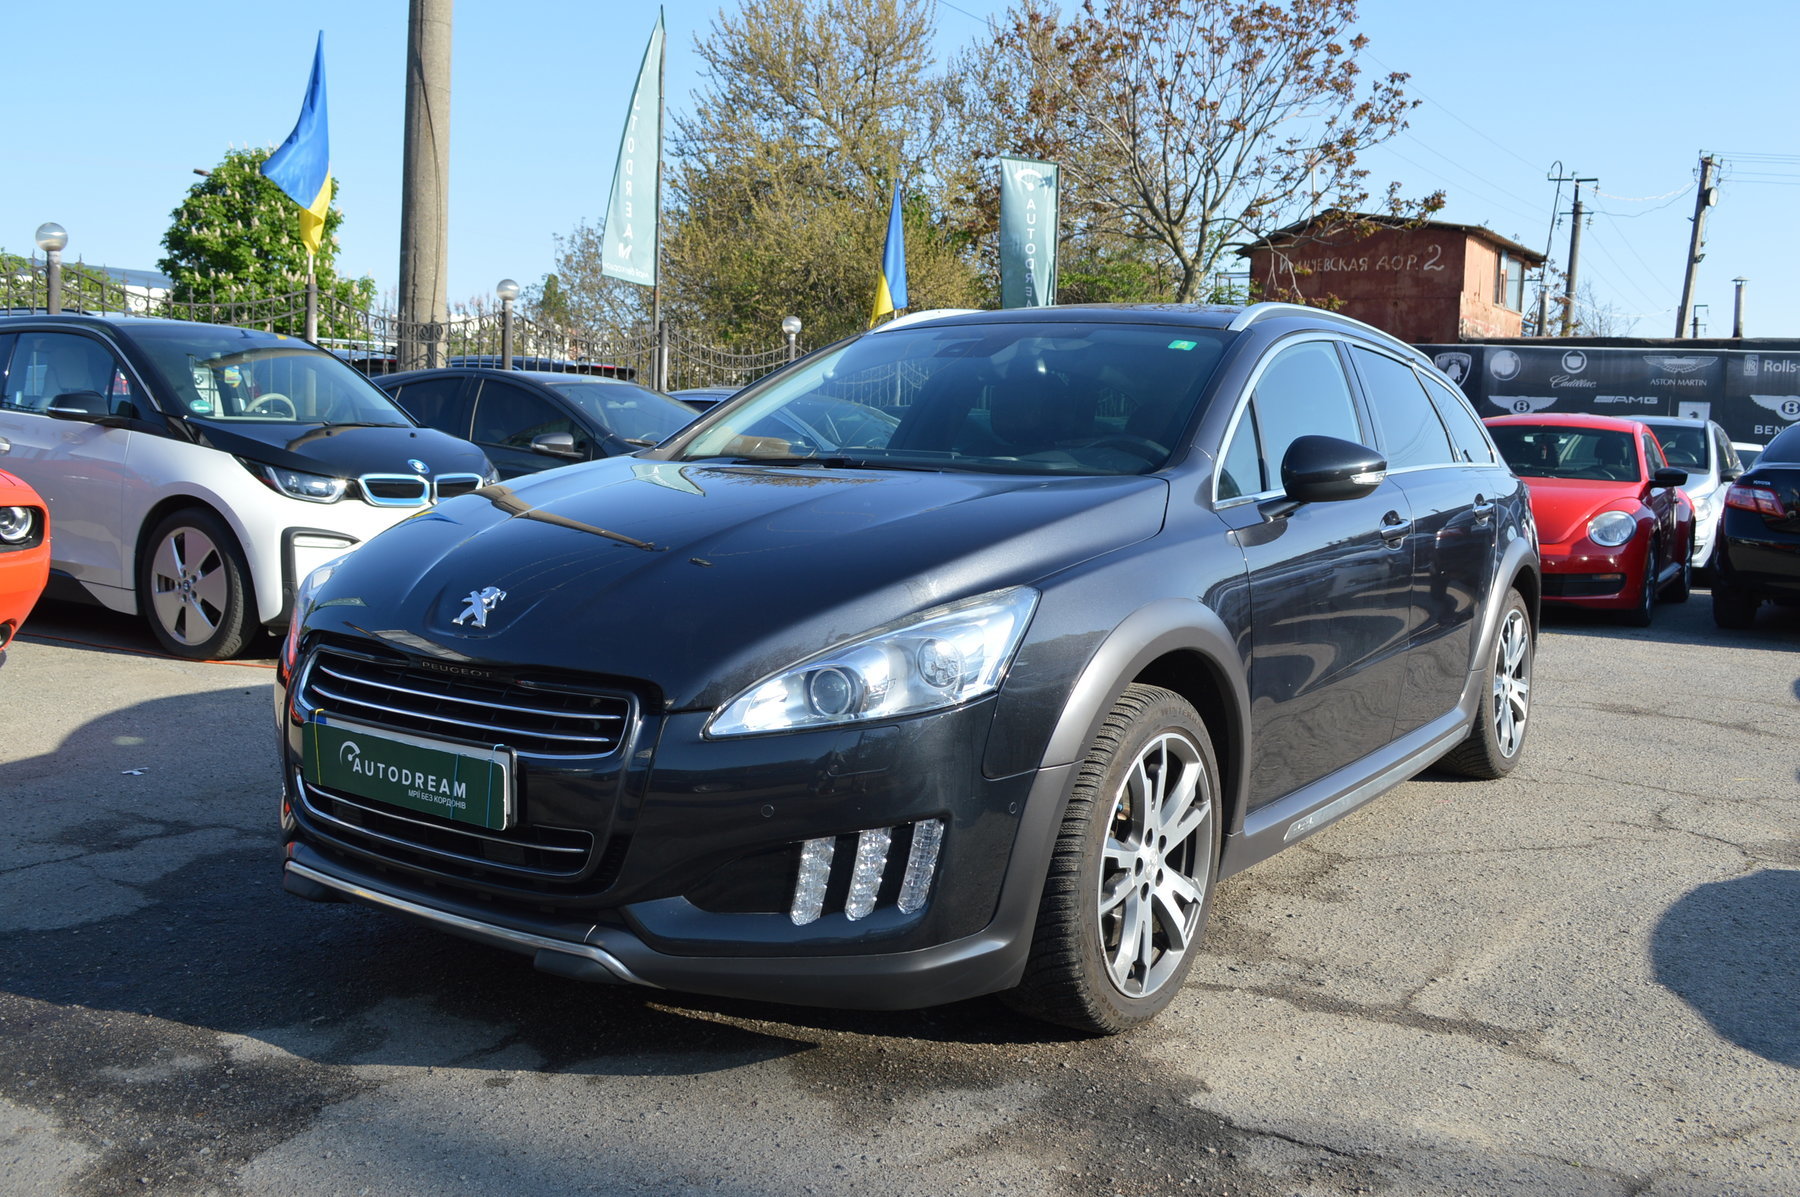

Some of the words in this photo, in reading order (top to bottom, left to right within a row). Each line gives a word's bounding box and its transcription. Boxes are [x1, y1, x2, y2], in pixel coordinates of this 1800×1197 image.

[1424, 244, 1445, 271] 2
[1763, 359, 1800, 373] Rolls-
[1550, 375, 1597, 389] Cadillac
[1650, 378, 1676, 386] ASTON
[1677, 379, 1708, 387] MARTIN
[1613, 395, 1659, 405] AMG
[422, 661, 494, 678] PEUGEOT
[352, 757, 466, 798] AUTODREAM
[421, 792, 433, 802] БЕЗ
[434, 795, 466, 810] КОРДОНІВ
